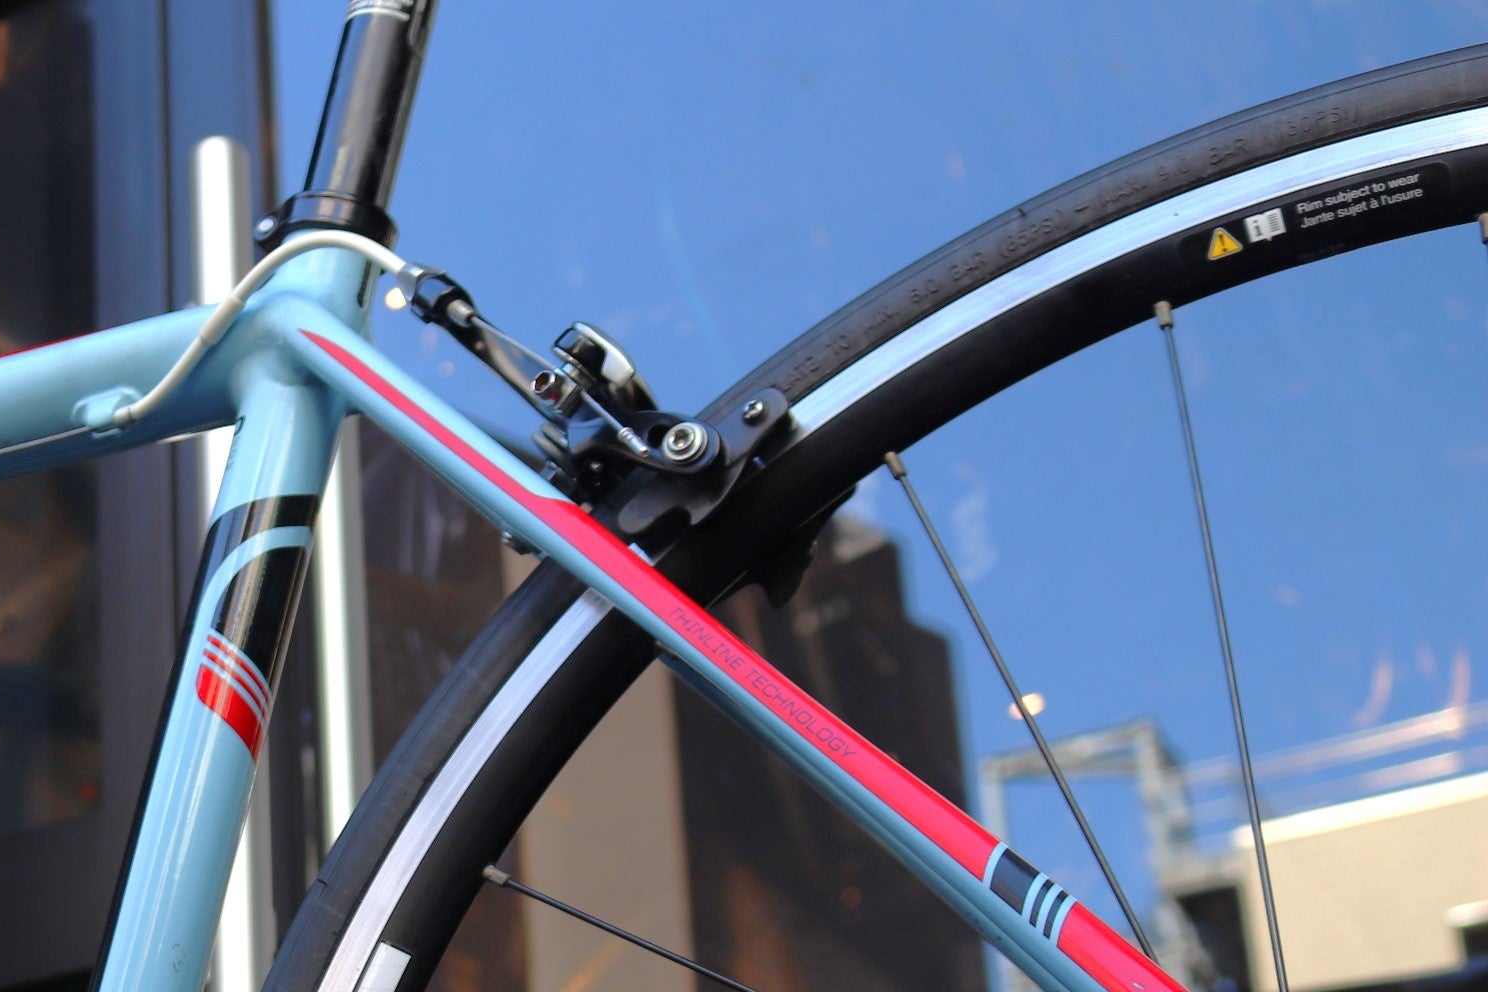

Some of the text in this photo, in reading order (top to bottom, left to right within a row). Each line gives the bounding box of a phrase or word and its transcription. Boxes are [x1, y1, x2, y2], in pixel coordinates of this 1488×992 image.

[1295, 173, 1420, 214] Rim subject to wear
[1301, 211, 1335, 228] Jante
[1337, 200, 1369, 217] sujet
[1370, 198, 1380, 209] à
[669, 606, 858, 759] THINLINE TECHNOLOGY
